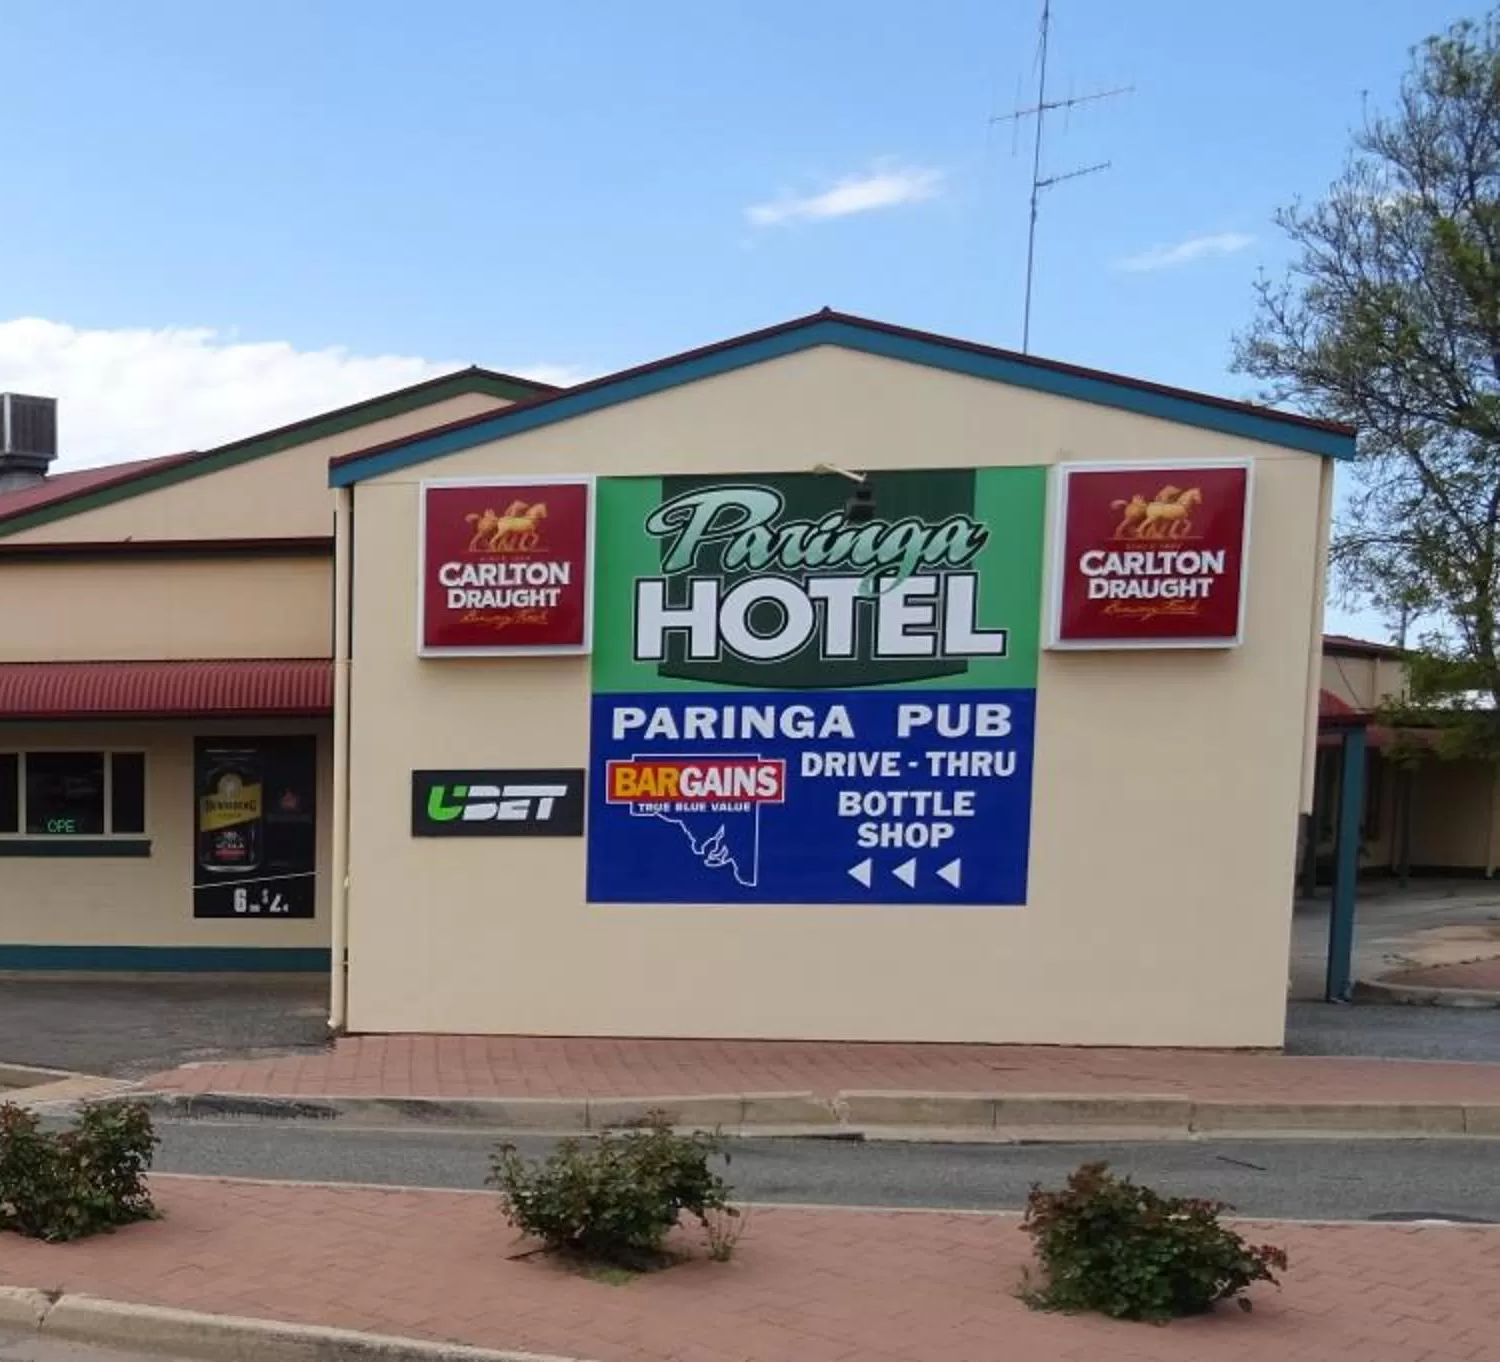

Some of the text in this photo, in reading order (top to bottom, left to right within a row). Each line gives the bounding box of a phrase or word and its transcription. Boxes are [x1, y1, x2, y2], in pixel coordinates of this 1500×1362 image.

[645, 484, 991, 598] Paringa
[439, 562, 571, 587] CARLTON
[1079, 551, 1225, 576] CARLTON
[447, 588, 561, 609] DRAUGHT
[1088, 578, 1213, 599] DRAUGHT
[633, 574, 1007, 662] HOTEL
[611, 703, 1013, 740] PARINGA PUB
[801, 751, 901, 777] DRIVE
[925, 751, 1016, 777] THRU
[615, 766, 778, 797] BARGAINS
[426, 784, 568, 822] UBET
[639, 803, 750, 813] TRUE BLUE VALUE
[838, 791, 975, 816] BOTTLE
[857, 822, 955, 848] SHOP
